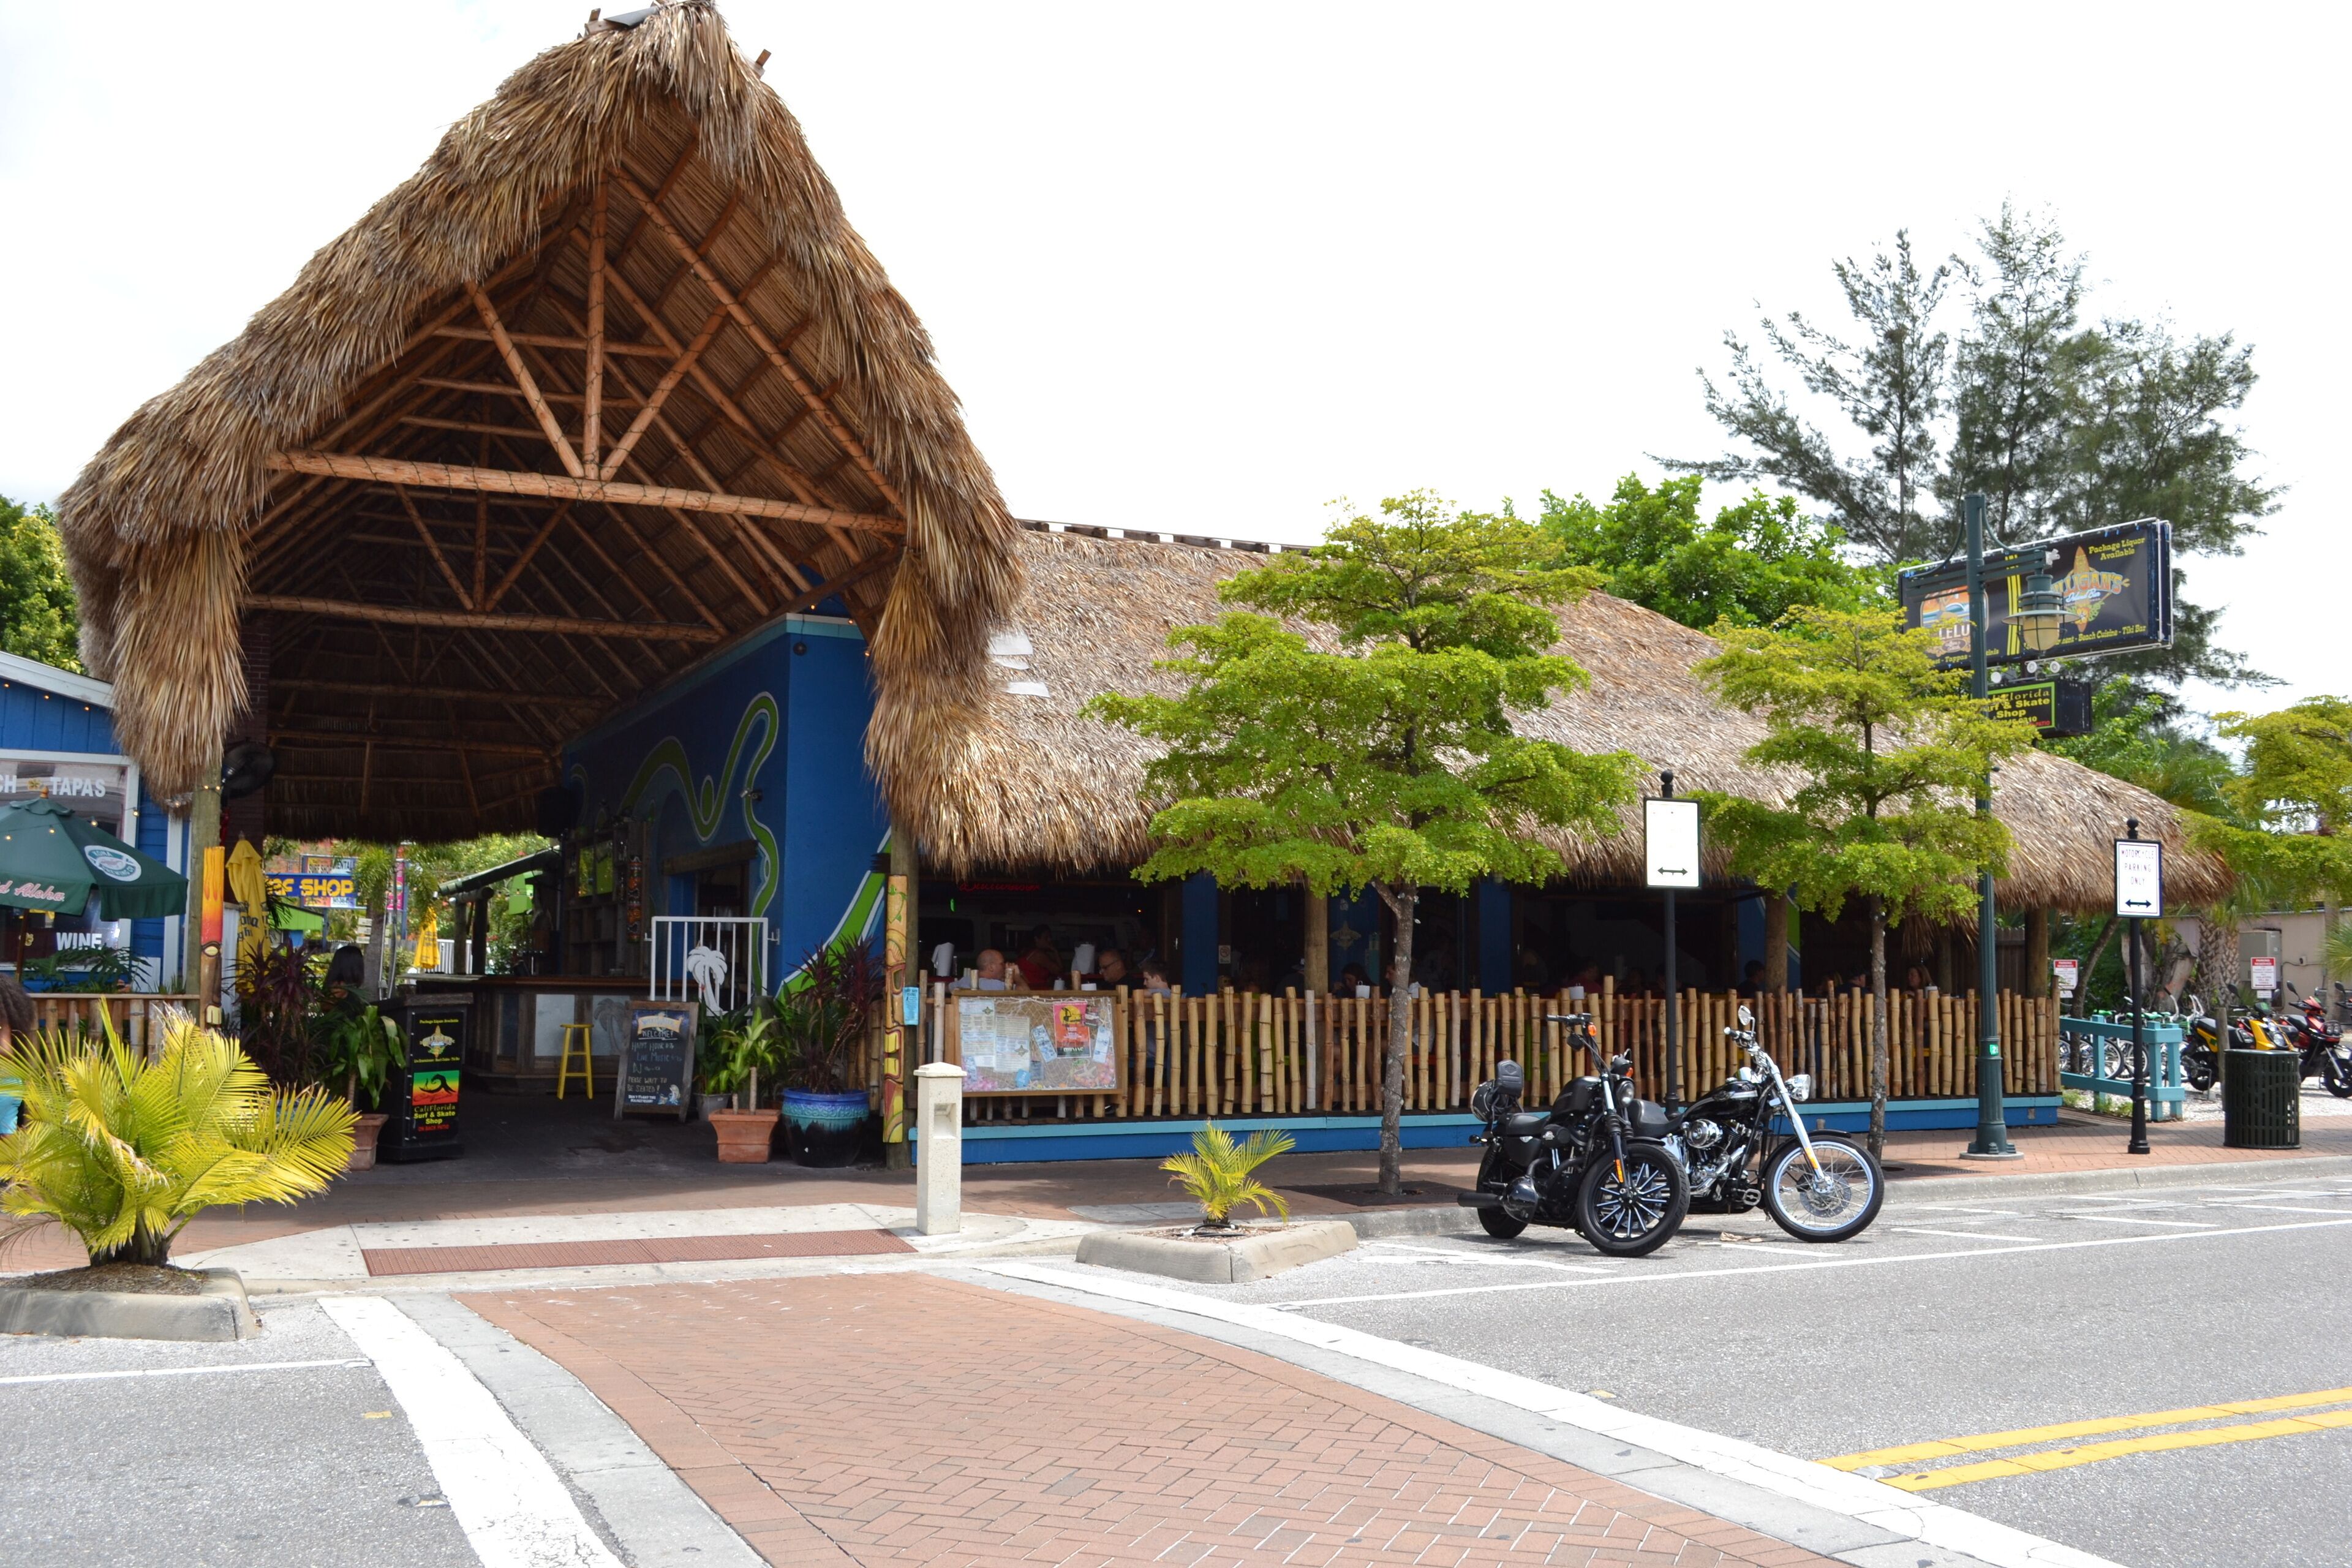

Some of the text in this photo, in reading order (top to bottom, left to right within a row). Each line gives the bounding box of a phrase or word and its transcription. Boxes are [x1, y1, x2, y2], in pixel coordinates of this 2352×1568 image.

[2088, 537, 2146, 554] Package Liquor
[2100, 548, 2136, 561] Available
[2051, 571, 2123, 599] ILLIGAN'S
[2078, 631, 2096, 643] Beach
[2097, 628, 2119, 639] Cuisine
[2122, 625, 2134, 635] Tiki
[2135, 624, 2147, 633] Bar
[2015, 698, 2051, 709] Skate
[1996, 709, 2027, 719] Shop
[50, 776, 107, 798] TAPAS
[2121, 849, 2154, 859] MOTORCYCLE
[2124, 862, 2152, 872] PARKING
[301, 878, 354, 897] SHOP
[2130, 876, 2145, 886] ONLY
[56, 932, 103, 951] WINE
[414, 1104, 456, 1112] CaliFlorida
